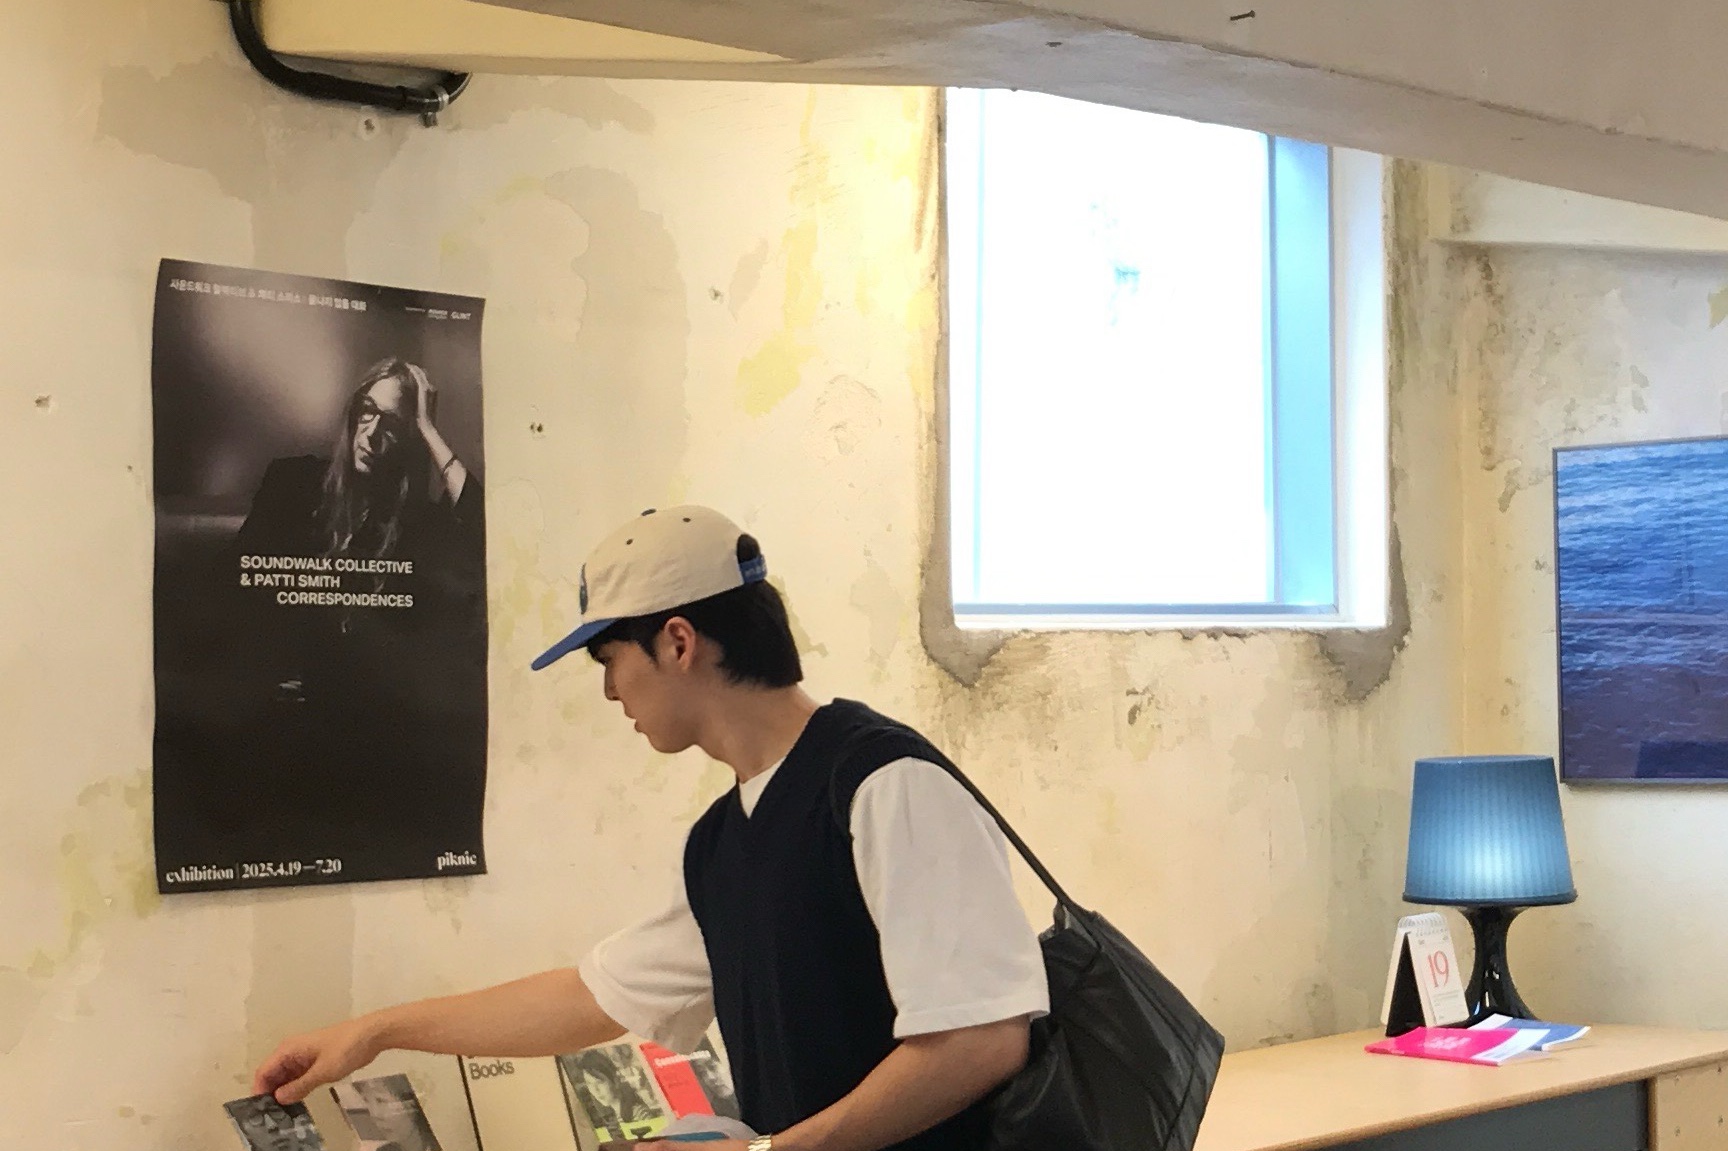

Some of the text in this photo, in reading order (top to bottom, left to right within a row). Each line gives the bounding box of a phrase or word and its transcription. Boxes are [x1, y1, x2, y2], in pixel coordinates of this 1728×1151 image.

[240, 555, 413, 574] SOUNDWALK COLLECTIVE
[240, 573, 341, 588] & PATTI SMITH
[277, 591, 414, 608] CORRESPONDENCES
[437, 850, 477, 871] piknic
[1427, 950, 1450, 989] 19
[468, 1059, 515, 1081] Books
